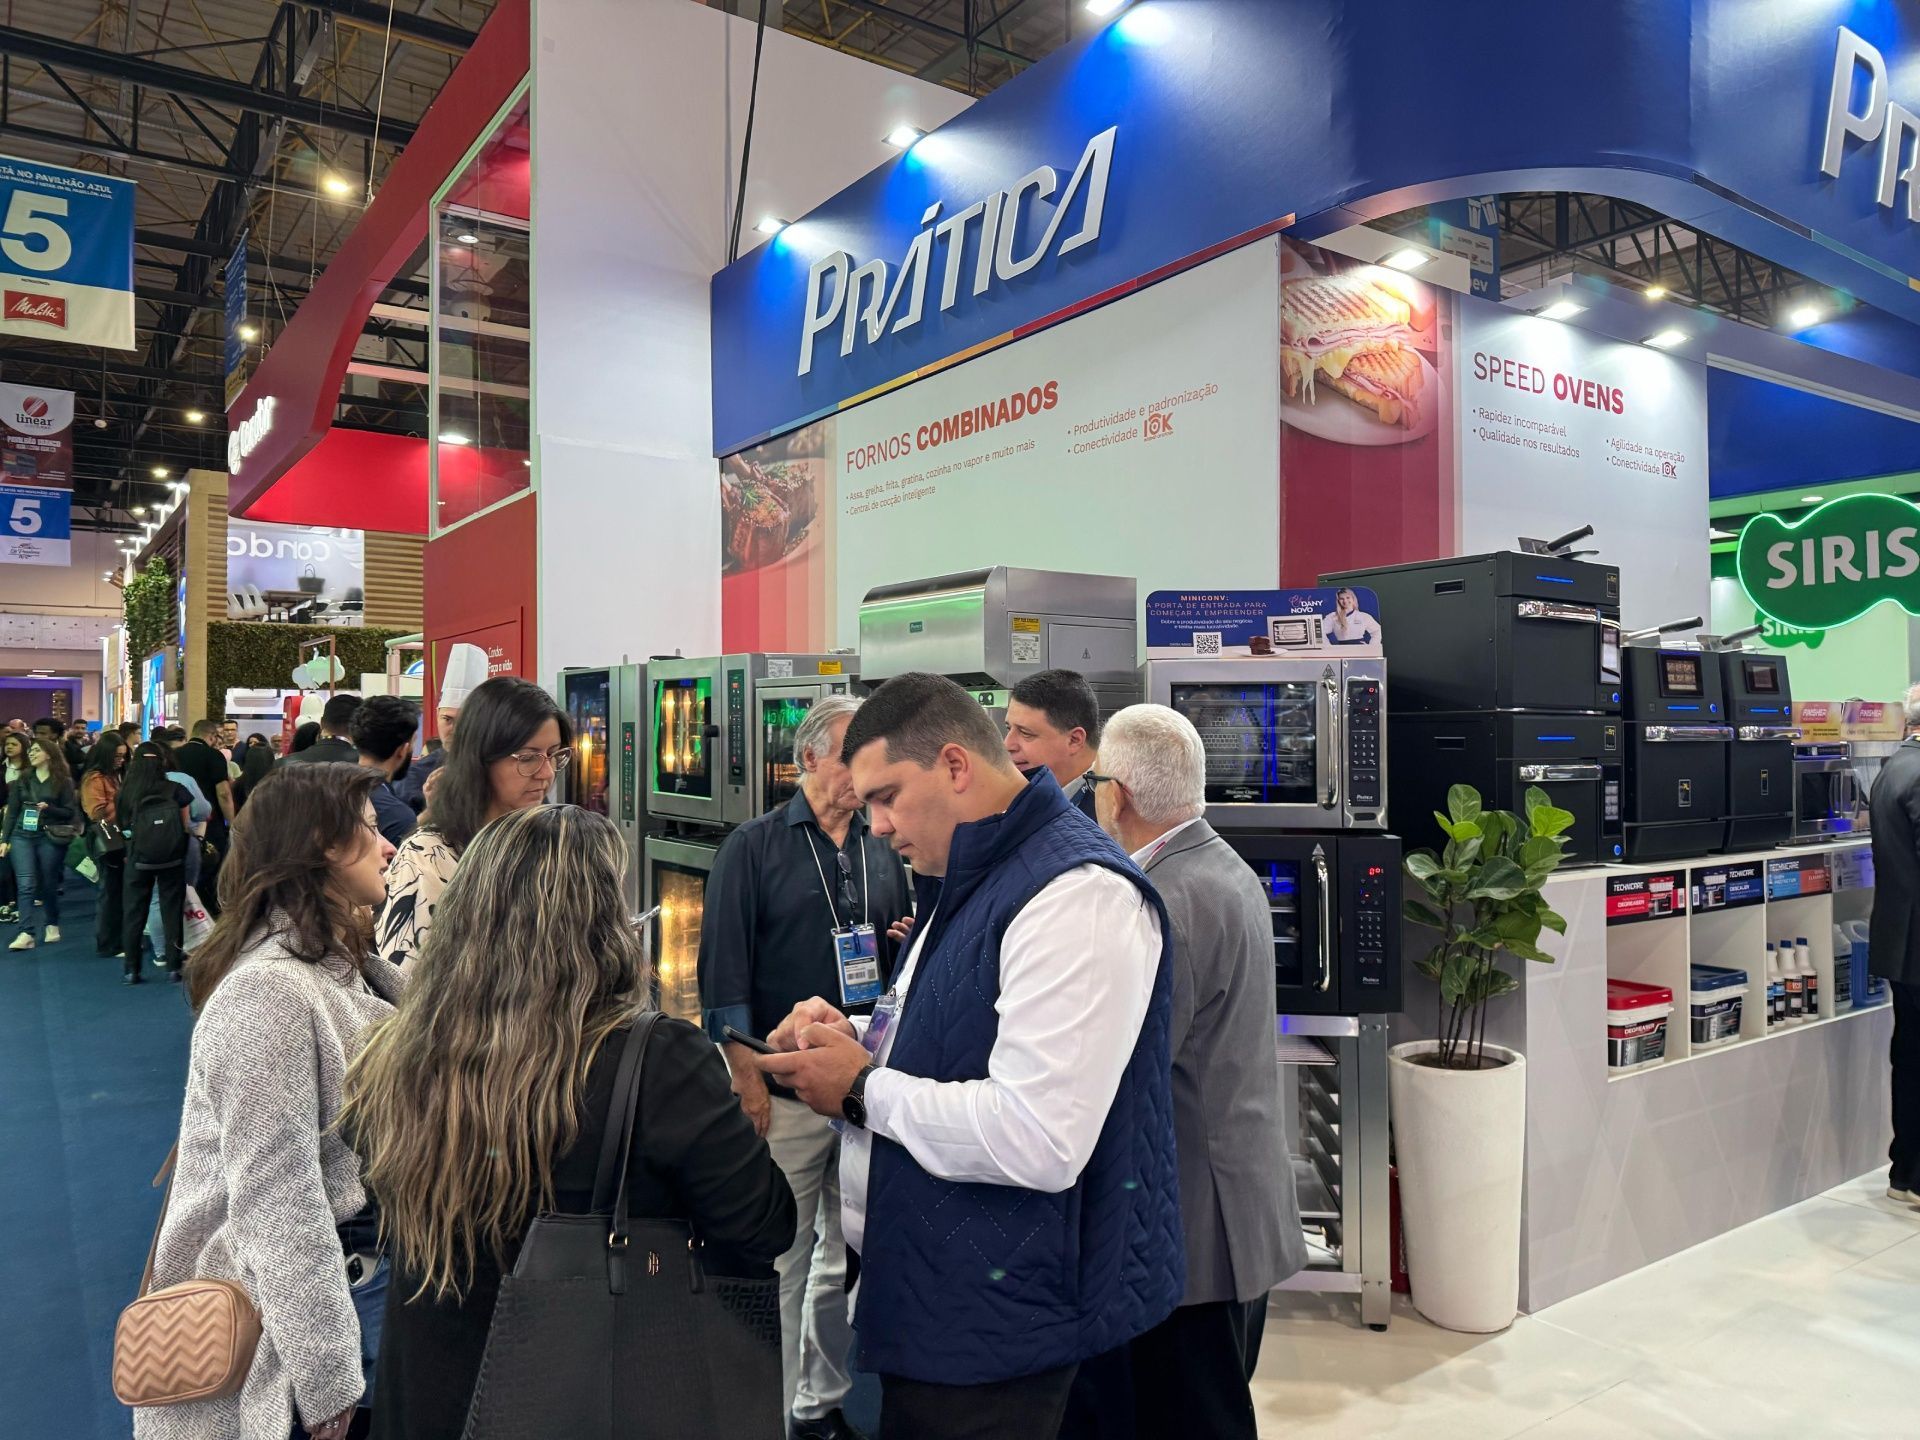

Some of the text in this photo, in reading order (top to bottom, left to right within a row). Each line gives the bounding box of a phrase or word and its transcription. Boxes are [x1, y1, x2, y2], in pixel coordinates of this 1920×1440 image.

[35, 172, 85, 188] PAVILHÃO
[87, 182, 113, 194] AZUL
[0, 189, 72, 272] 5
[1473, 352, 1624, 414] SPEED OVENS
[16, 414, 53, 426] linear
[1074, 408, 1136, 436] Produtividade
[1139, 406, 1145, 416] e
[1148, 383, 1219, 414] padronização
[1479, 407, 1568, 438] Rapidez incomparável
[846, 380, 1059, 473] FORNOS COMBINADOS
[1073, 427, 1138, 455] Conectividade
[1479, 427, 1580, 458] Qualidade nos resultados
[1611, 438, 1685, 464] Agilidade na operação
[926, 465, 952, 481] cozinha
[953, 461, 962, 471] no
[963, 456, 984, 474] vapor
[985, 452, 990, 462] e
[991, 445, 1014, 460] muito
[1016, 439, 1036, 454] mais
[1611, 455, 1661, 475] Conectividade
[902, 485, 936, 502] inteligente
[8, 498, 43, 535] 5
[1766, 527, 1920, 589] SIRIS
[1291, 606, 1313, 614] NOVO
[1301, 599, 1323, 607] DANY
